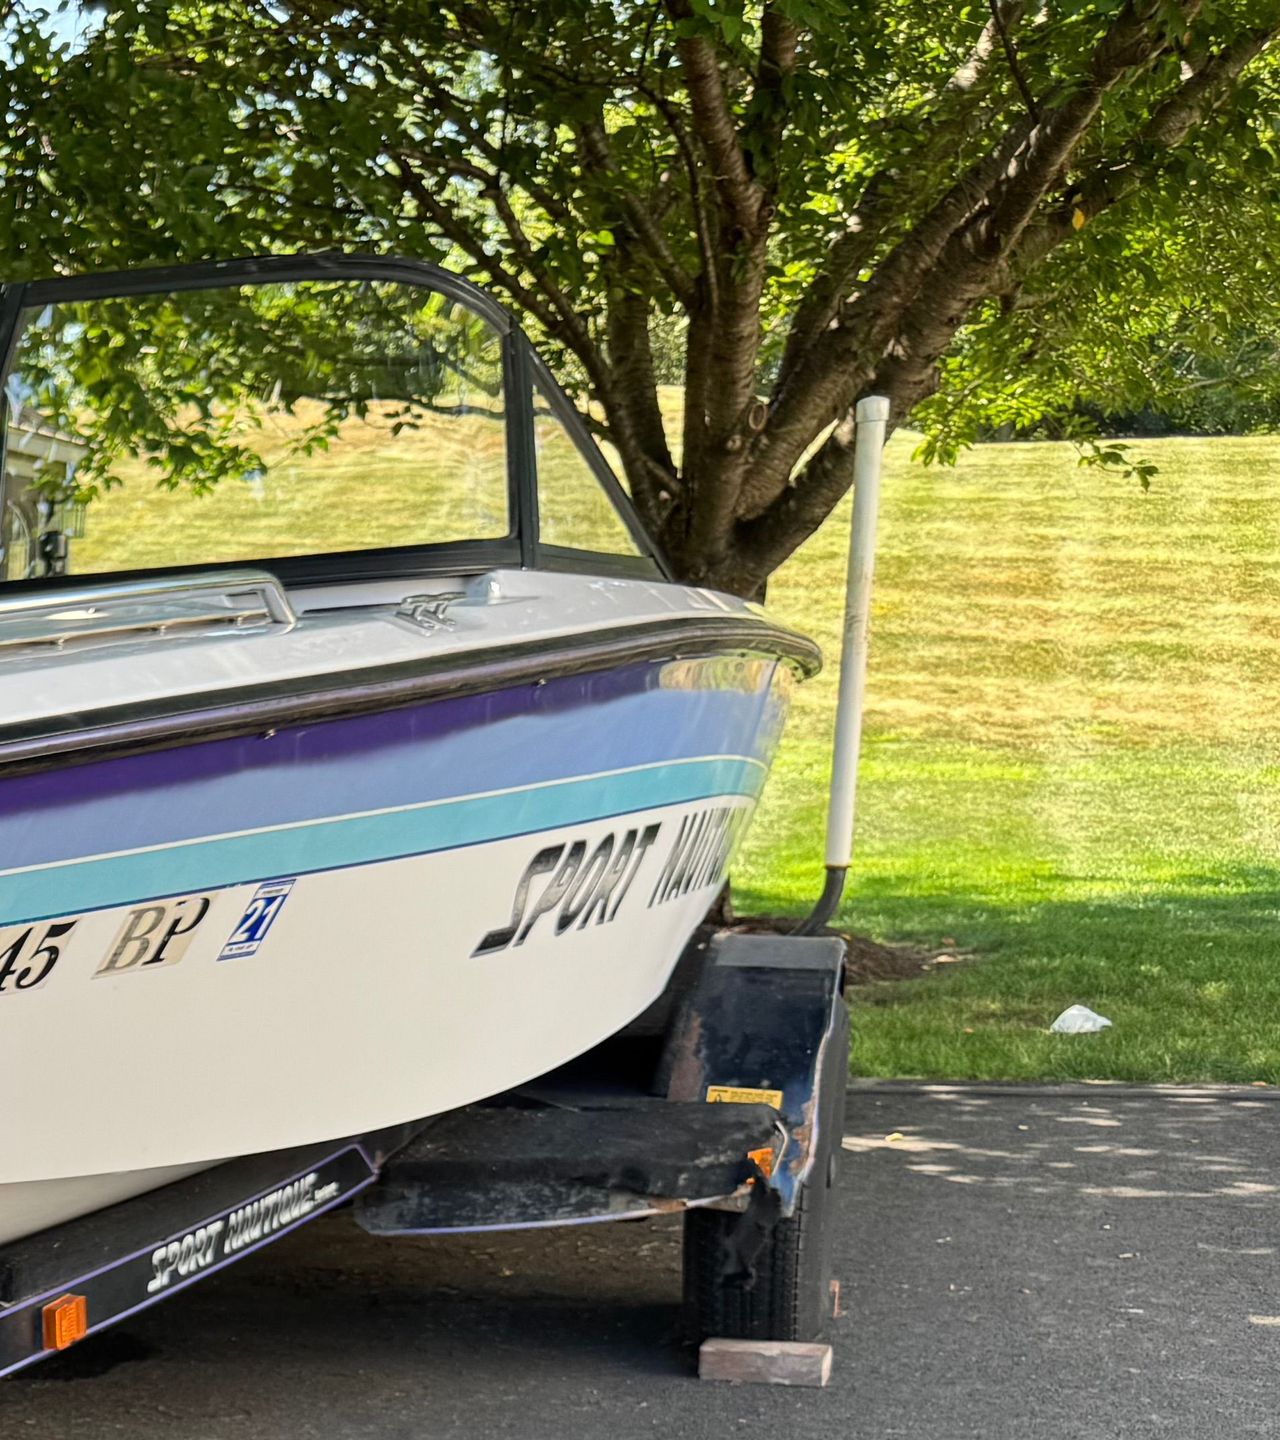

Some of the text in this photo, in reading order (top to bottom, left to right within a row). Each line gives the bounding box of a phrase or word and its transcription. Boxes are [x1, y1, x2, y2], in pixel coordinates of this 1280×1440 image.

[469, 806, 746, 958] SPORT NAUTI
[147, 1172, 319, 1293] SPORT NAUTIQUE
